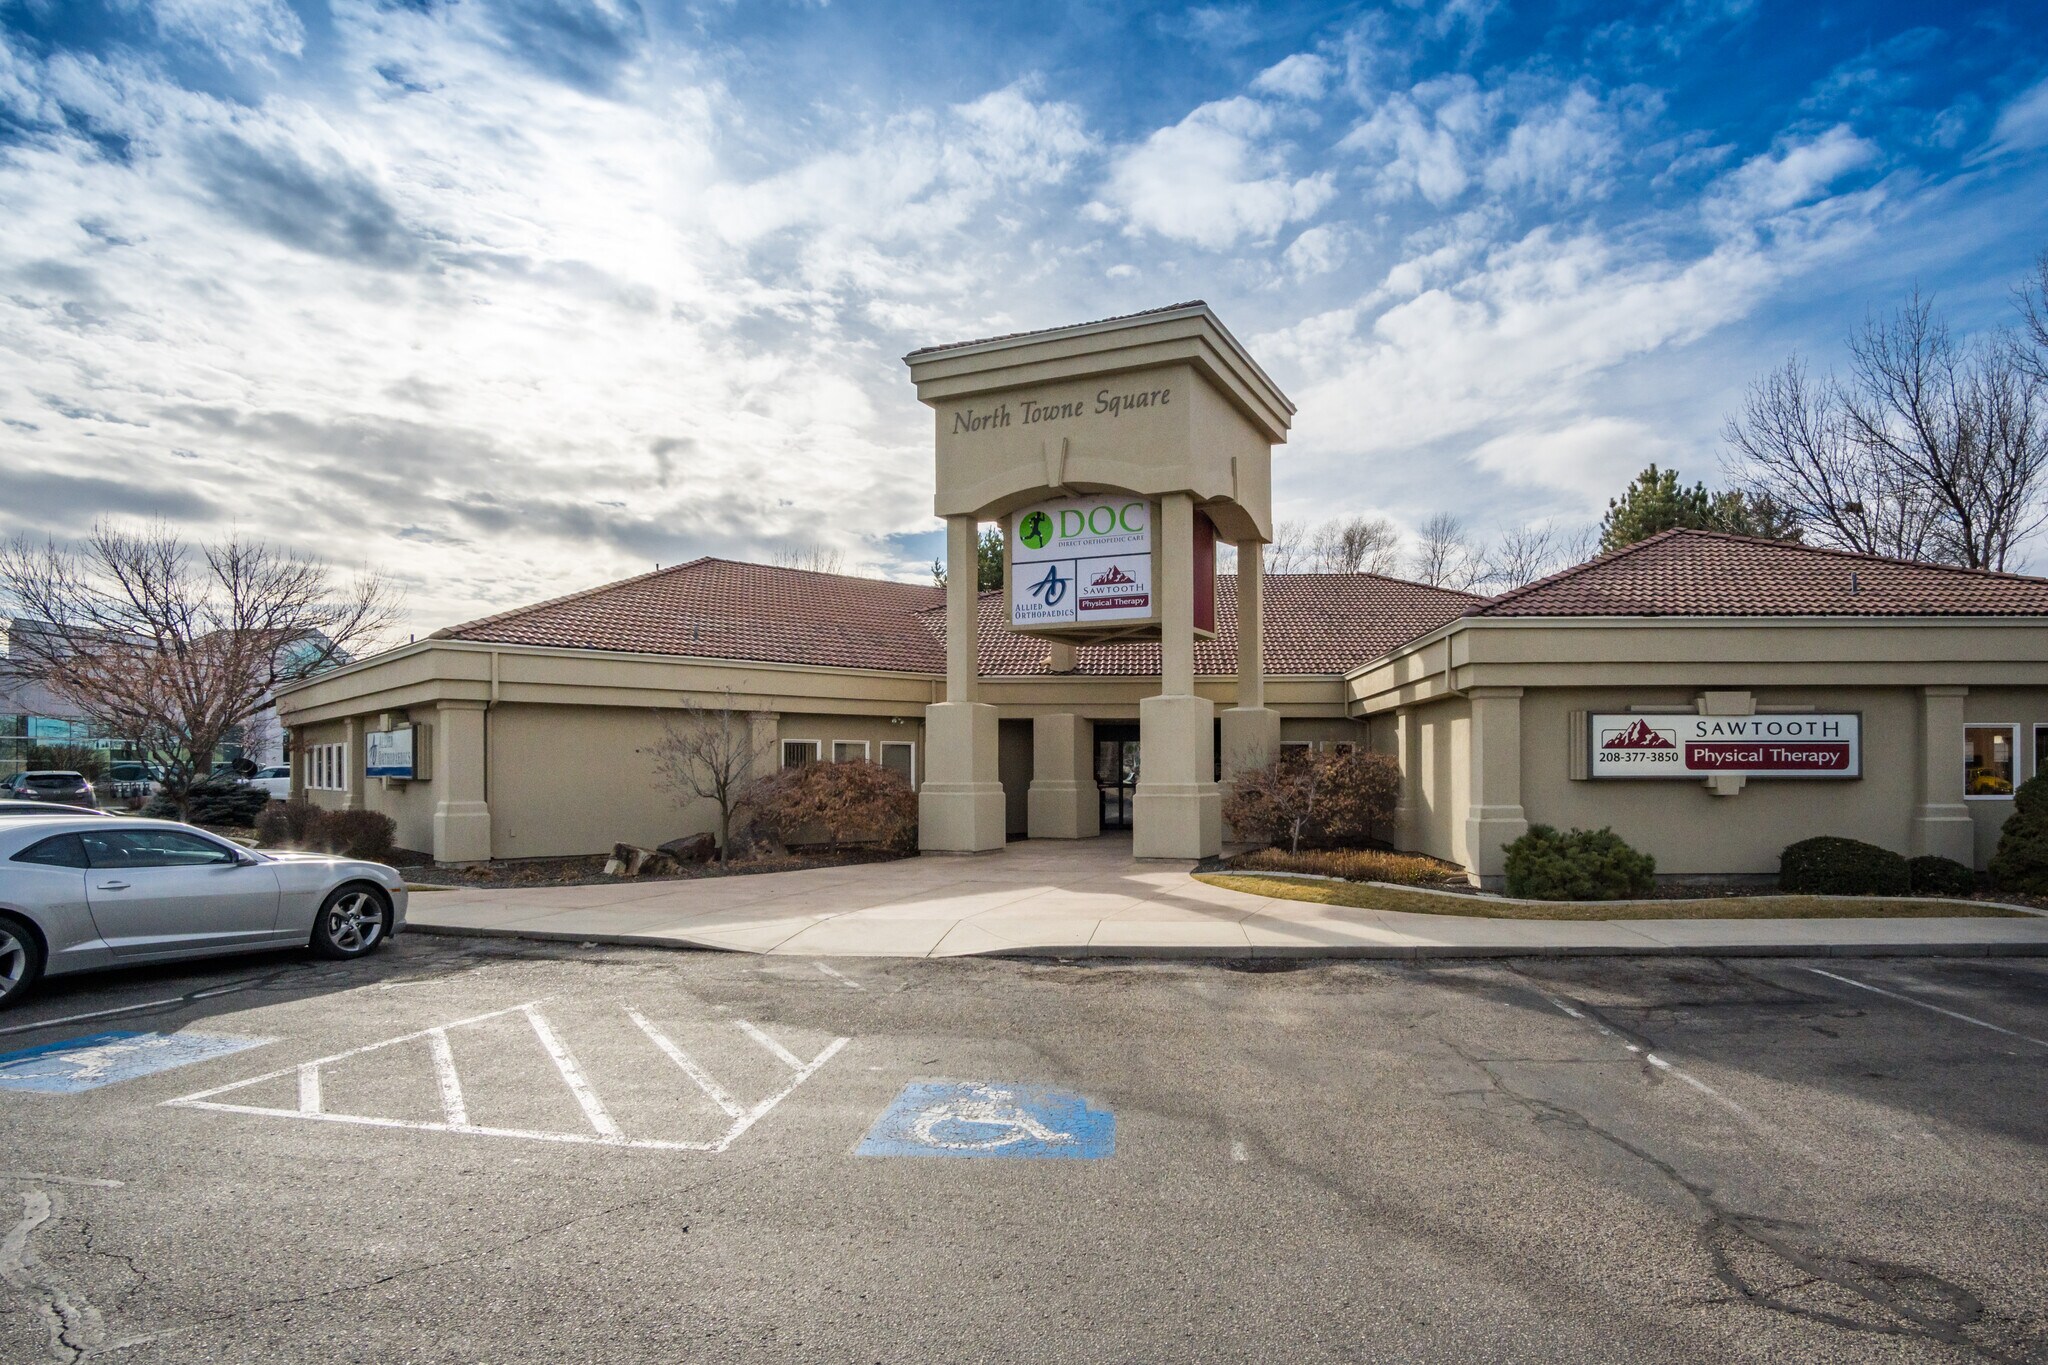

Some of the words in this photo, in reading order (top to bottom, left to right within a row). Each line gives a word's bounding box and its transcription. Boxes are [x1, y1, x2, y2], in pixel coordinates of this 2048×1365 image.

[952, 404, 1010, 434] North
[1020, 400, 1083, 425] Towne
[1095, 388, 1171, 417] Square
[1058, 502, 1144, 538] DOC
[1058, 539, 1081, 547] DIRECT
[1083, 536, 1126, 545] ORTHOPEDIC
[1083, 583, 1144, 595] SAWTOOTH
[1015, 604, 1043, 612] ALLIED
[1082, 599, 1112, 608] Physical
[1114, 597, 1145, 606] Therapy
[1015, 609, 1075, 619] ORTHOPAEDICS
[1696, 721, 1839, 737] SAWTOOTH
[1599, 752, 1679, 762] 208-377-3850
[1693, 749, 1763, 766] Physical
[1769, 748, 1841, 769] Therapy
